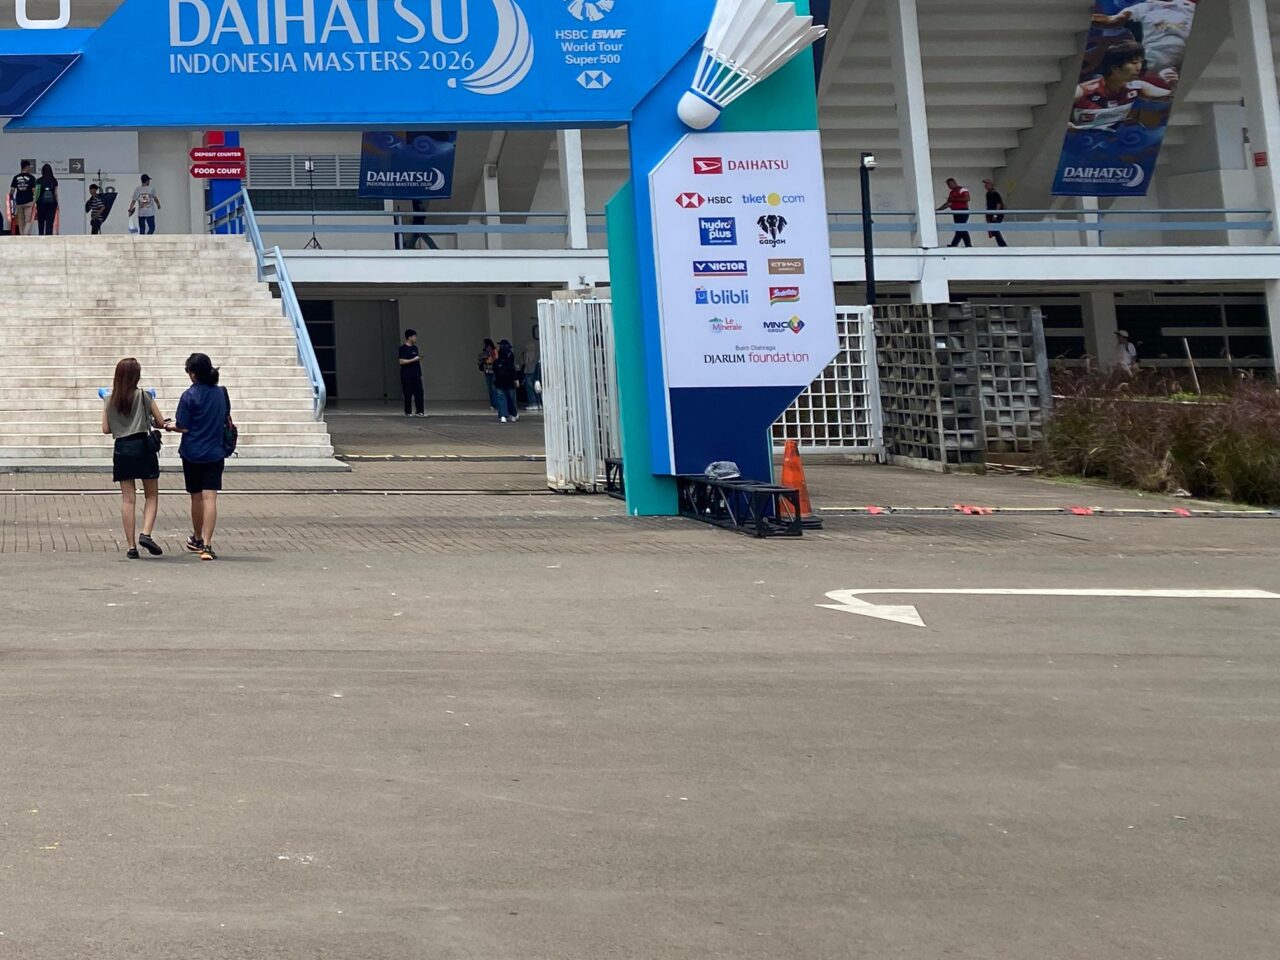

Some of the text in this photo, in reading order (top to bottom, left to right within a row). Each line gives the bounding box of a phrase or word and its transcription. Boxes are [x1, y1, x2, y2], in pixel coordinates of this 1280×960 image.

[555, 29, 627, 40] HSBC BWF
[561, 41, 623, 52] World Tour
[169, 50, 475, 74] INDONESIA MASTERS 2026
[565, 54, 621, 66] Super 500
[728, 159, 789, 171] DAIHATSU
[367, 170, 433, 182] DAIHATSU
[1064, 167, 1134, 178] DAIHATSU
[707, 196, 733, 204] HSBC
[709, 230, 732, 239] plus
[708, 262, 745, 271] VICTOR
[710, 289, 749, 304] blibli
[725, 317, 734, 325] Le
[712, 323, 742, 331] Minerale
[704, 352, 810, 364] DJARUM foundation
